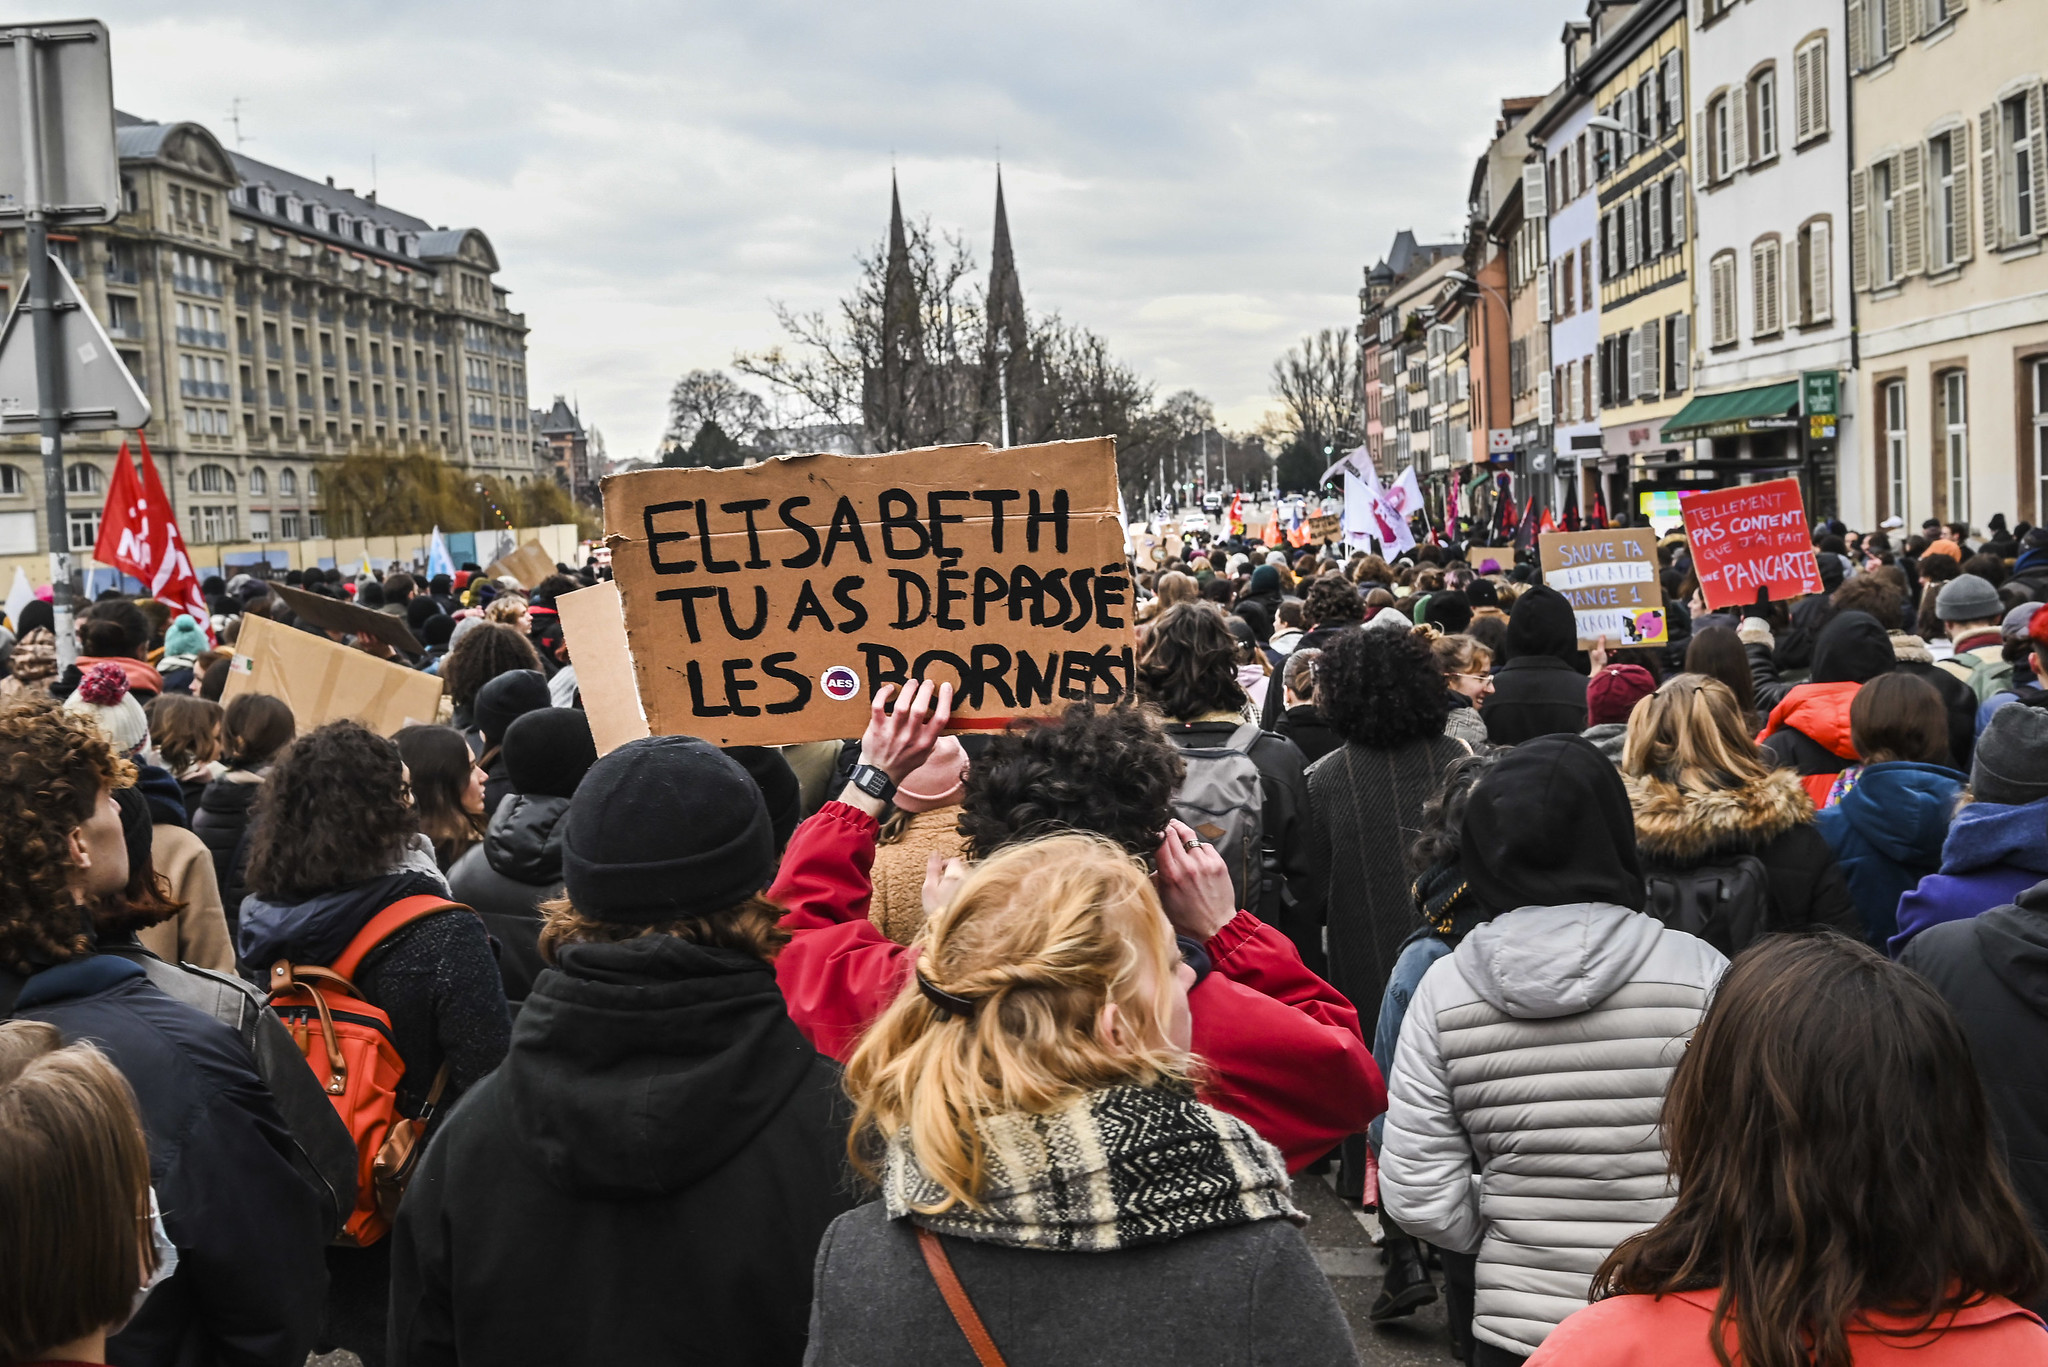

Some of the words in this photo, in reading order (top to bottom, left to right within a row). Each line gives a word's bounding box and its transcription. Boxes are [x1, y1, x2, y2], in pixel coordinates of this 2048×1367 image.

[1686, 492, 1787, 526] TELLEMENT
[643, 488, 1069, 575] ELISABETH
[1691, 521, 1726, 547] PAS
[1729, 510, 1802, 534] CONTENT
[1558, 542, 1616, 566] SAUVE
[1622, 540, 1643, 558] TA
[1703, 541, 1732, 563] QUE
[1723, 550, 1816, 592] PANCARTE
[655, 585, 768, 644] TU
[787, 575, 868, 634] AS
[887, 558, 1129, 634] DÉPASSÉ
[1561, 587, 1619, 607] MANGE
[1630, 585, 1642, 602] 1
[686, 652, 812, 717] LES
[827, 678, 854, 688] AES
